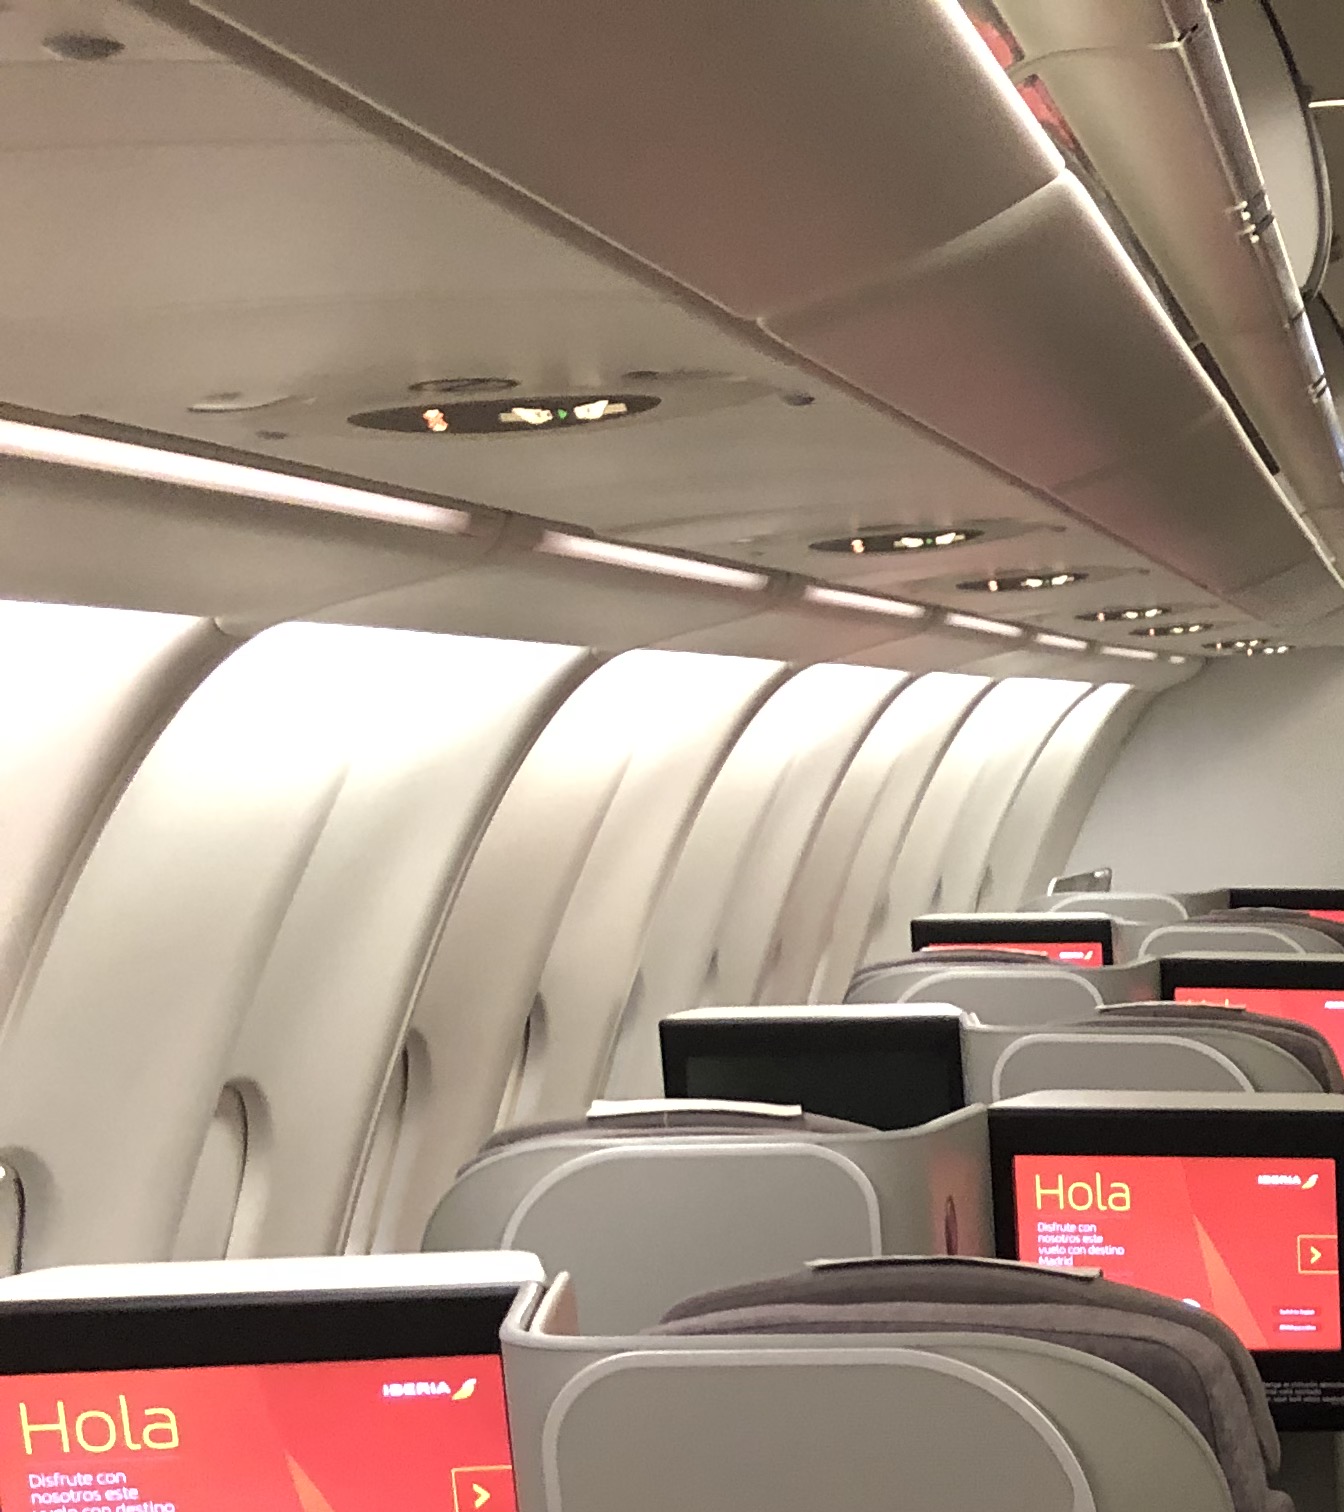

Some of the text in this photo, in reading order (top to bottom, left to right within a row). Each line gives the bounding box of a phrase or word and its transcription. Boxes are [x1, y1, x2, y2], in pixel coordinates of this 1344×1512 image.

[1035, 1172, 1130, 1211] Hola
[1078, 1223, 1097, 1233] con
[383, 1381, 450, 1398] IBERIA
[19, 1395, 179, 1455] Hola
[28, 1471, 127, 1488] Disfrute con
[31, 1487, 139, 1504] nosotros este
